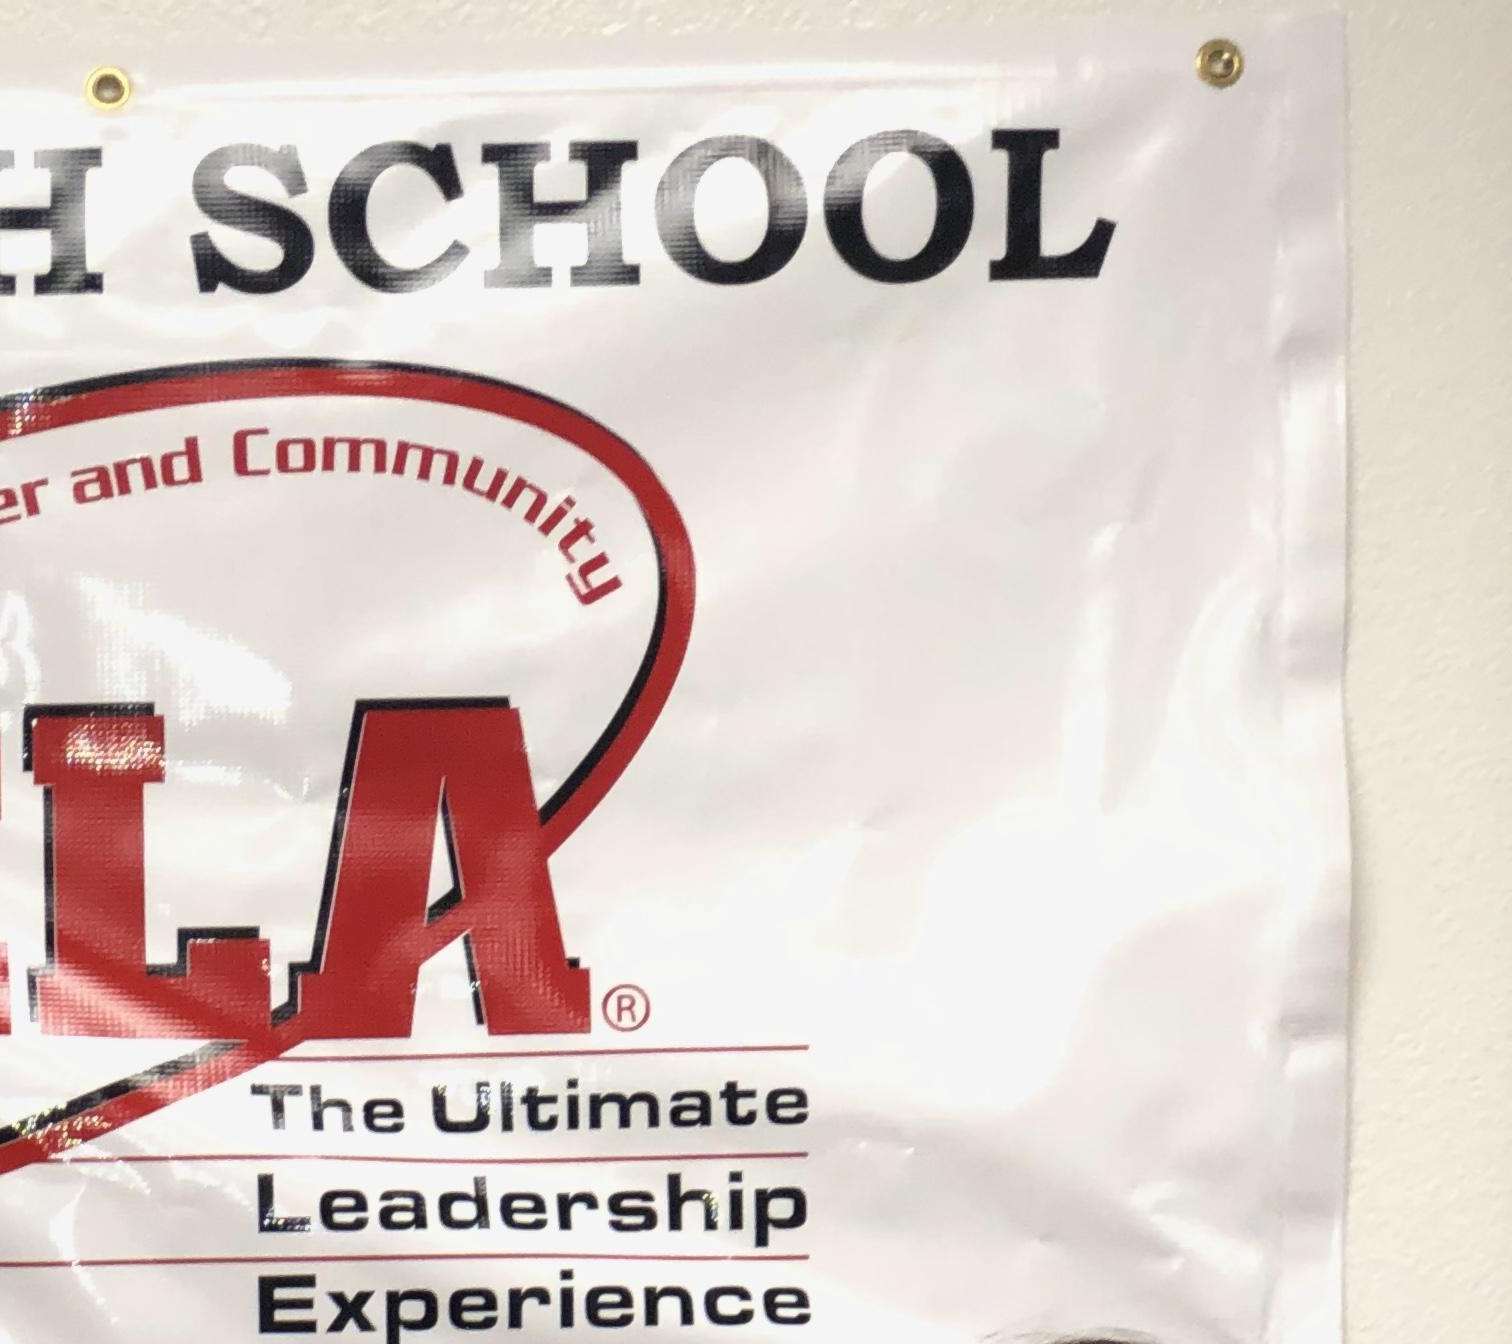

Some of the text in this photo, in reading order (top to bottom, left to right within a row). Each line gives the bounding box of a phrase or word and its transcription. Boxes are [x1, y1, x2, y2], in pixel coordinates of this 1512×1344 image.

[187, 126, 1117, 296] SCHOOL
[71, 434, 202, 502] and
[231, 426, 624, 607] Community
[250, 1078, 810, 1135] The Ultimate
[256, 1172, 808, 1248] Leadership
